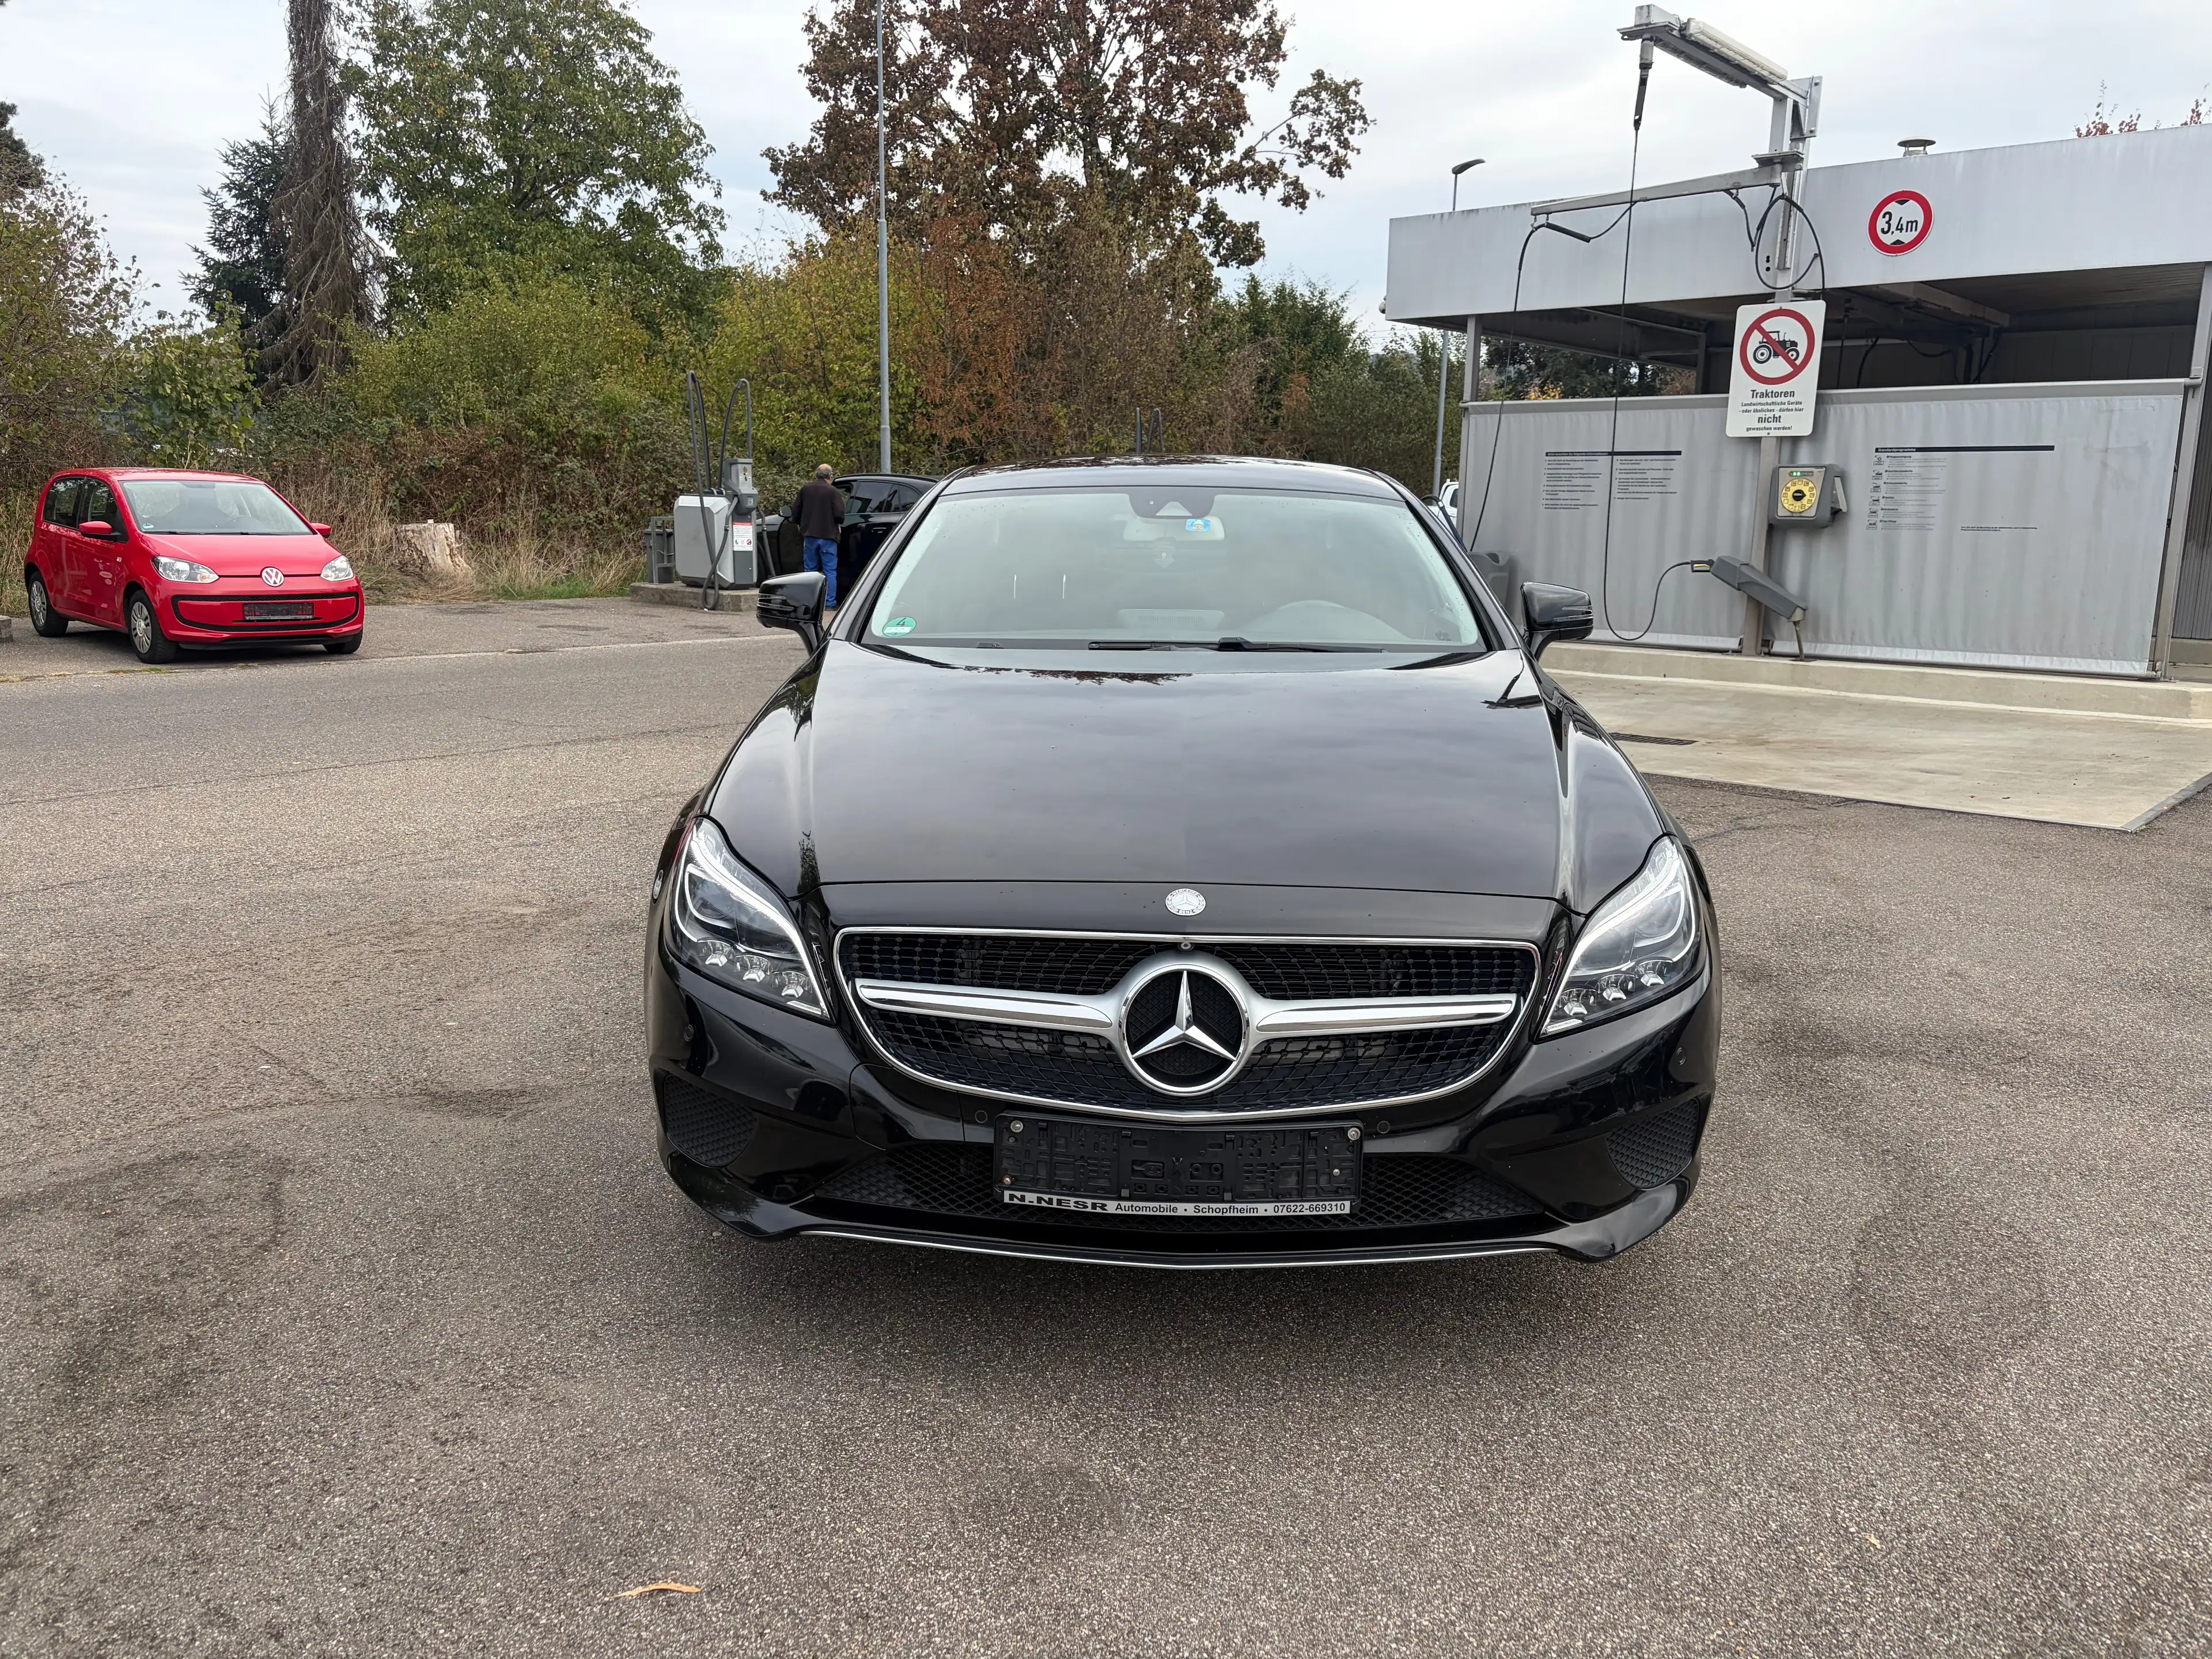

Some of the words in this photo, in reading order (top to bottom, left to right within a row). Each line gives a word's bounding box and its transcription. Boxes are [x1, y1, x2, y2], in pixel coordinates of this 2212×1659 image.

[1751, 389, 1795, 399] Traktoren
[1758, 414, 1782, 423] nicht
[896, 618, 907, 627] 4
[1009, 1194, 1108, 1211] N.NESR
[1115, 1203, 1178, 1213] Automobile
[1194, 1205, 1258, 1215] Schopfheim
[1273, 1203, 1345, 1213] 07622-669310
